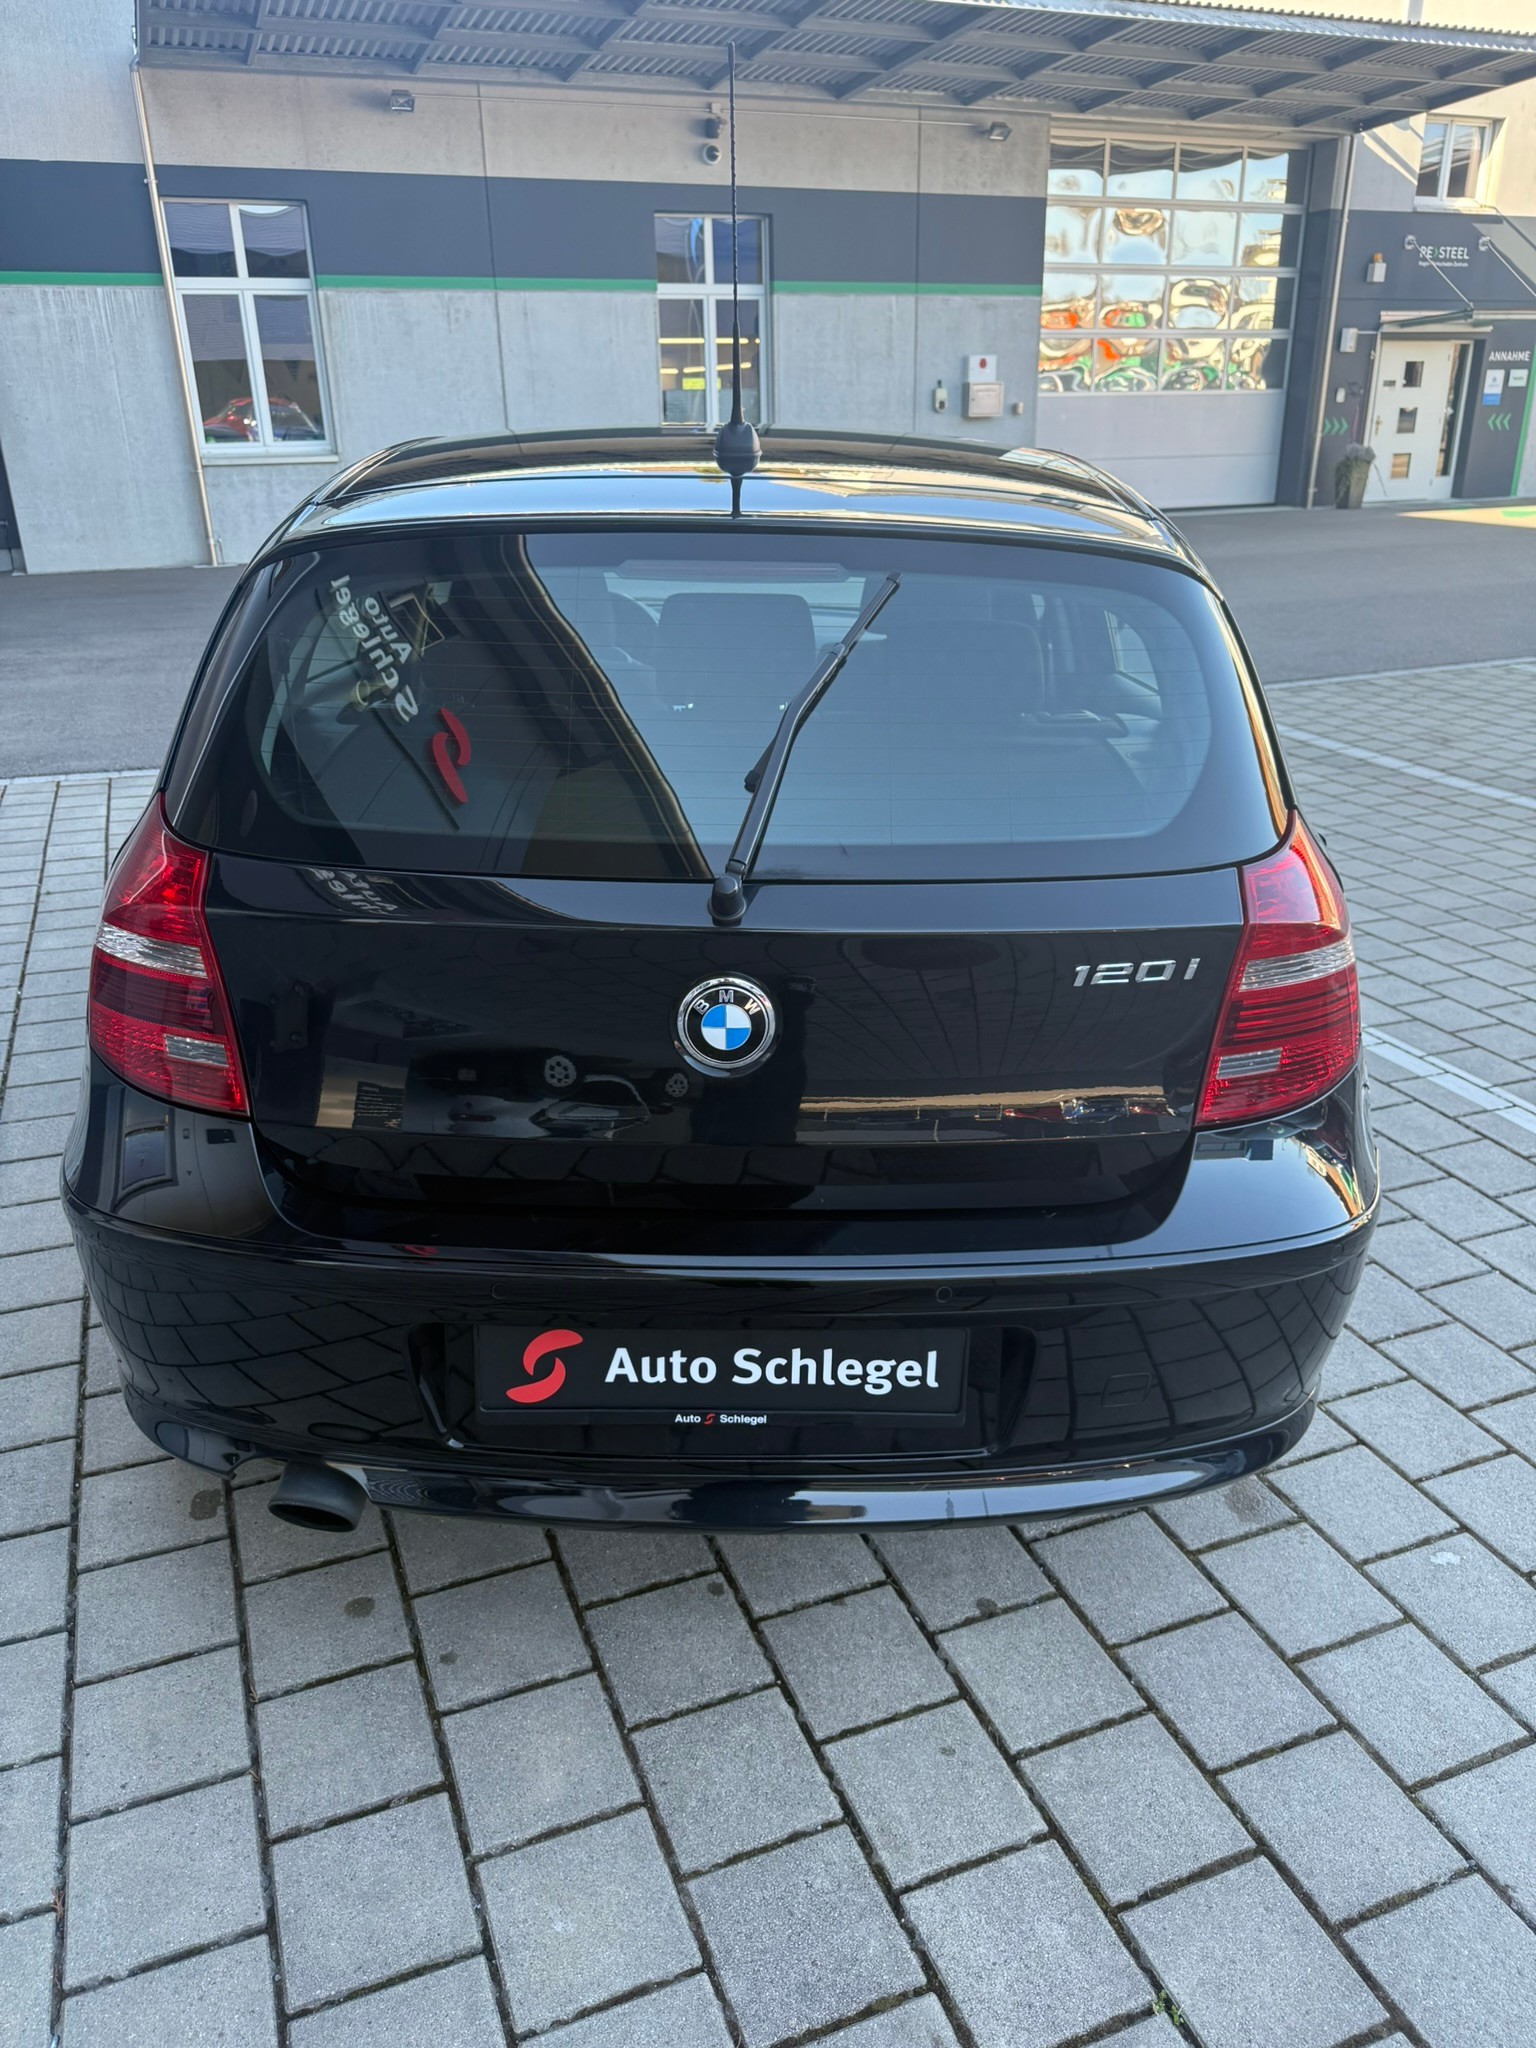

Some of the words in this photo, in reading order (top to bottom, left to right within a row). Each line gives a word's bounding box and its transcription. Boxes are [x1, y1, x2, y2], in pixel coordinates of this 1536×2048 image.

[1488, 350, 1531, 362] ANNAHME
[692, 988, 763, 1017] BMW
[604, 1347, 717, 1384] Auto
[732, 1347, 940, 1395] Schlegel
[674, 1414, 702, 1425] Auto
[719, 1413, 767, 1426] Schlegel
